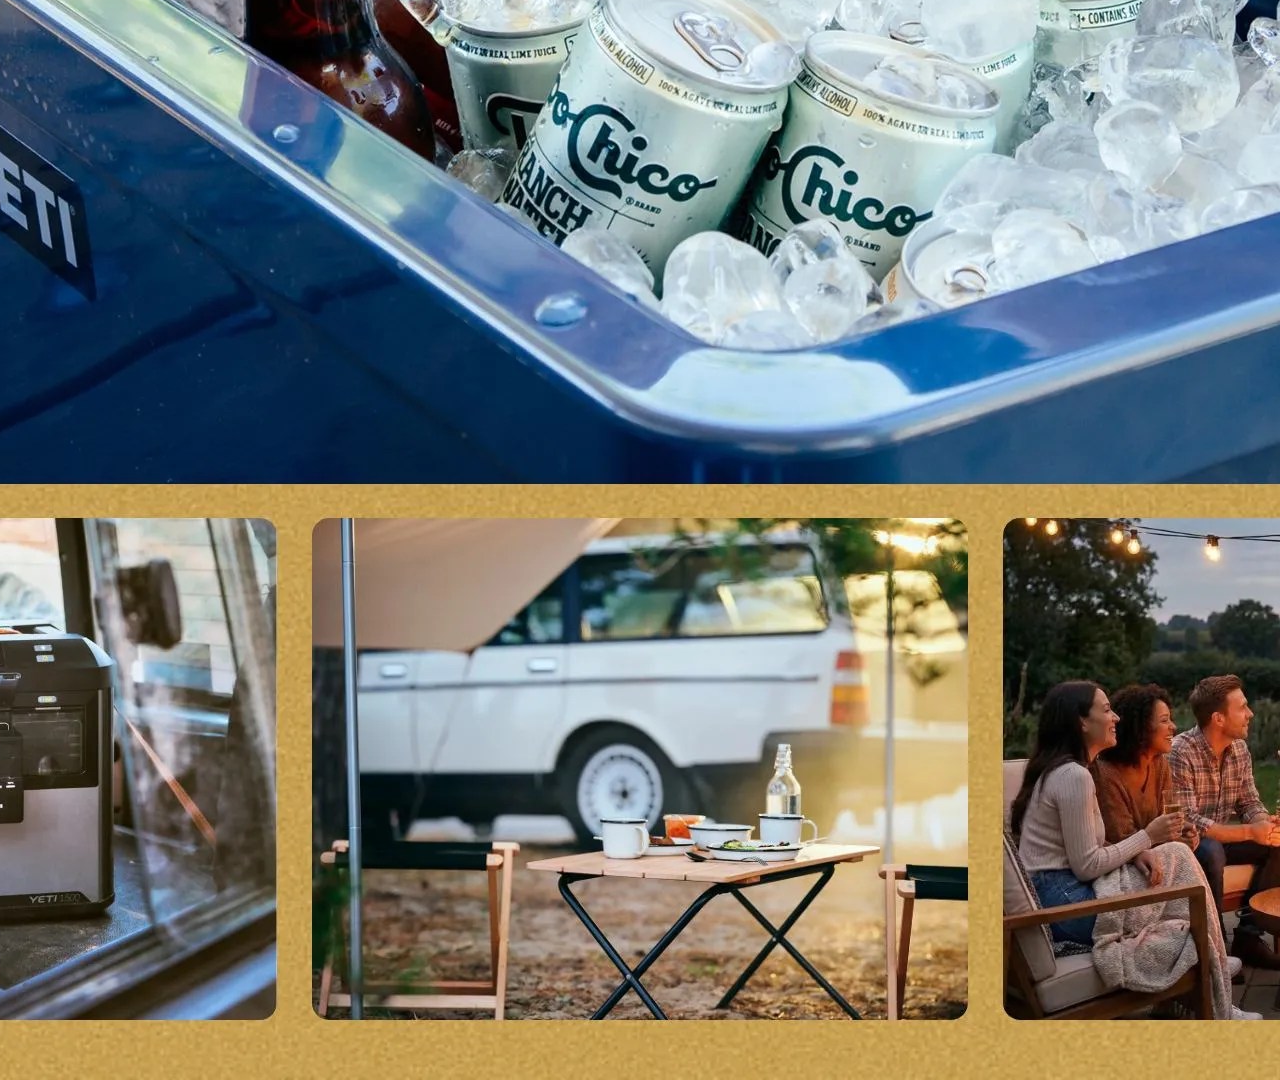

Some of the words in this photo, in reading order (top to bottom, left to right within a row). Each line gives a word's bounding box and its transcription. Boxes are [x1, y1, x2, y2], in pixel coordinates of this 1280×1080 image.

[1088, 7, 1128, 25] CONTAINS
[489, 49, 510, 60] REAL
[511, 49, 532, 59] LIME
[533, 46, 558, 58] JUICE
[982, 62, 1001, 75] LIME
[614, 47, 648, 81] ALCOHOL
[658, 79, 680, 96] 100%
[681, 91, 712, 108] AGAVE
[819, 84, 852, 112] ALCOHOL
[862, 108, 885, 124] 100%
[887, 118, 917, 133] AGAVE
[568, 104, 719, 203] Chico
[782, 145, 933, 237] Chico
[634, 200, 662, 215] BRAND
[853, 239, 881, 253] BRAND
[30, 894, 58, 904] YETI
